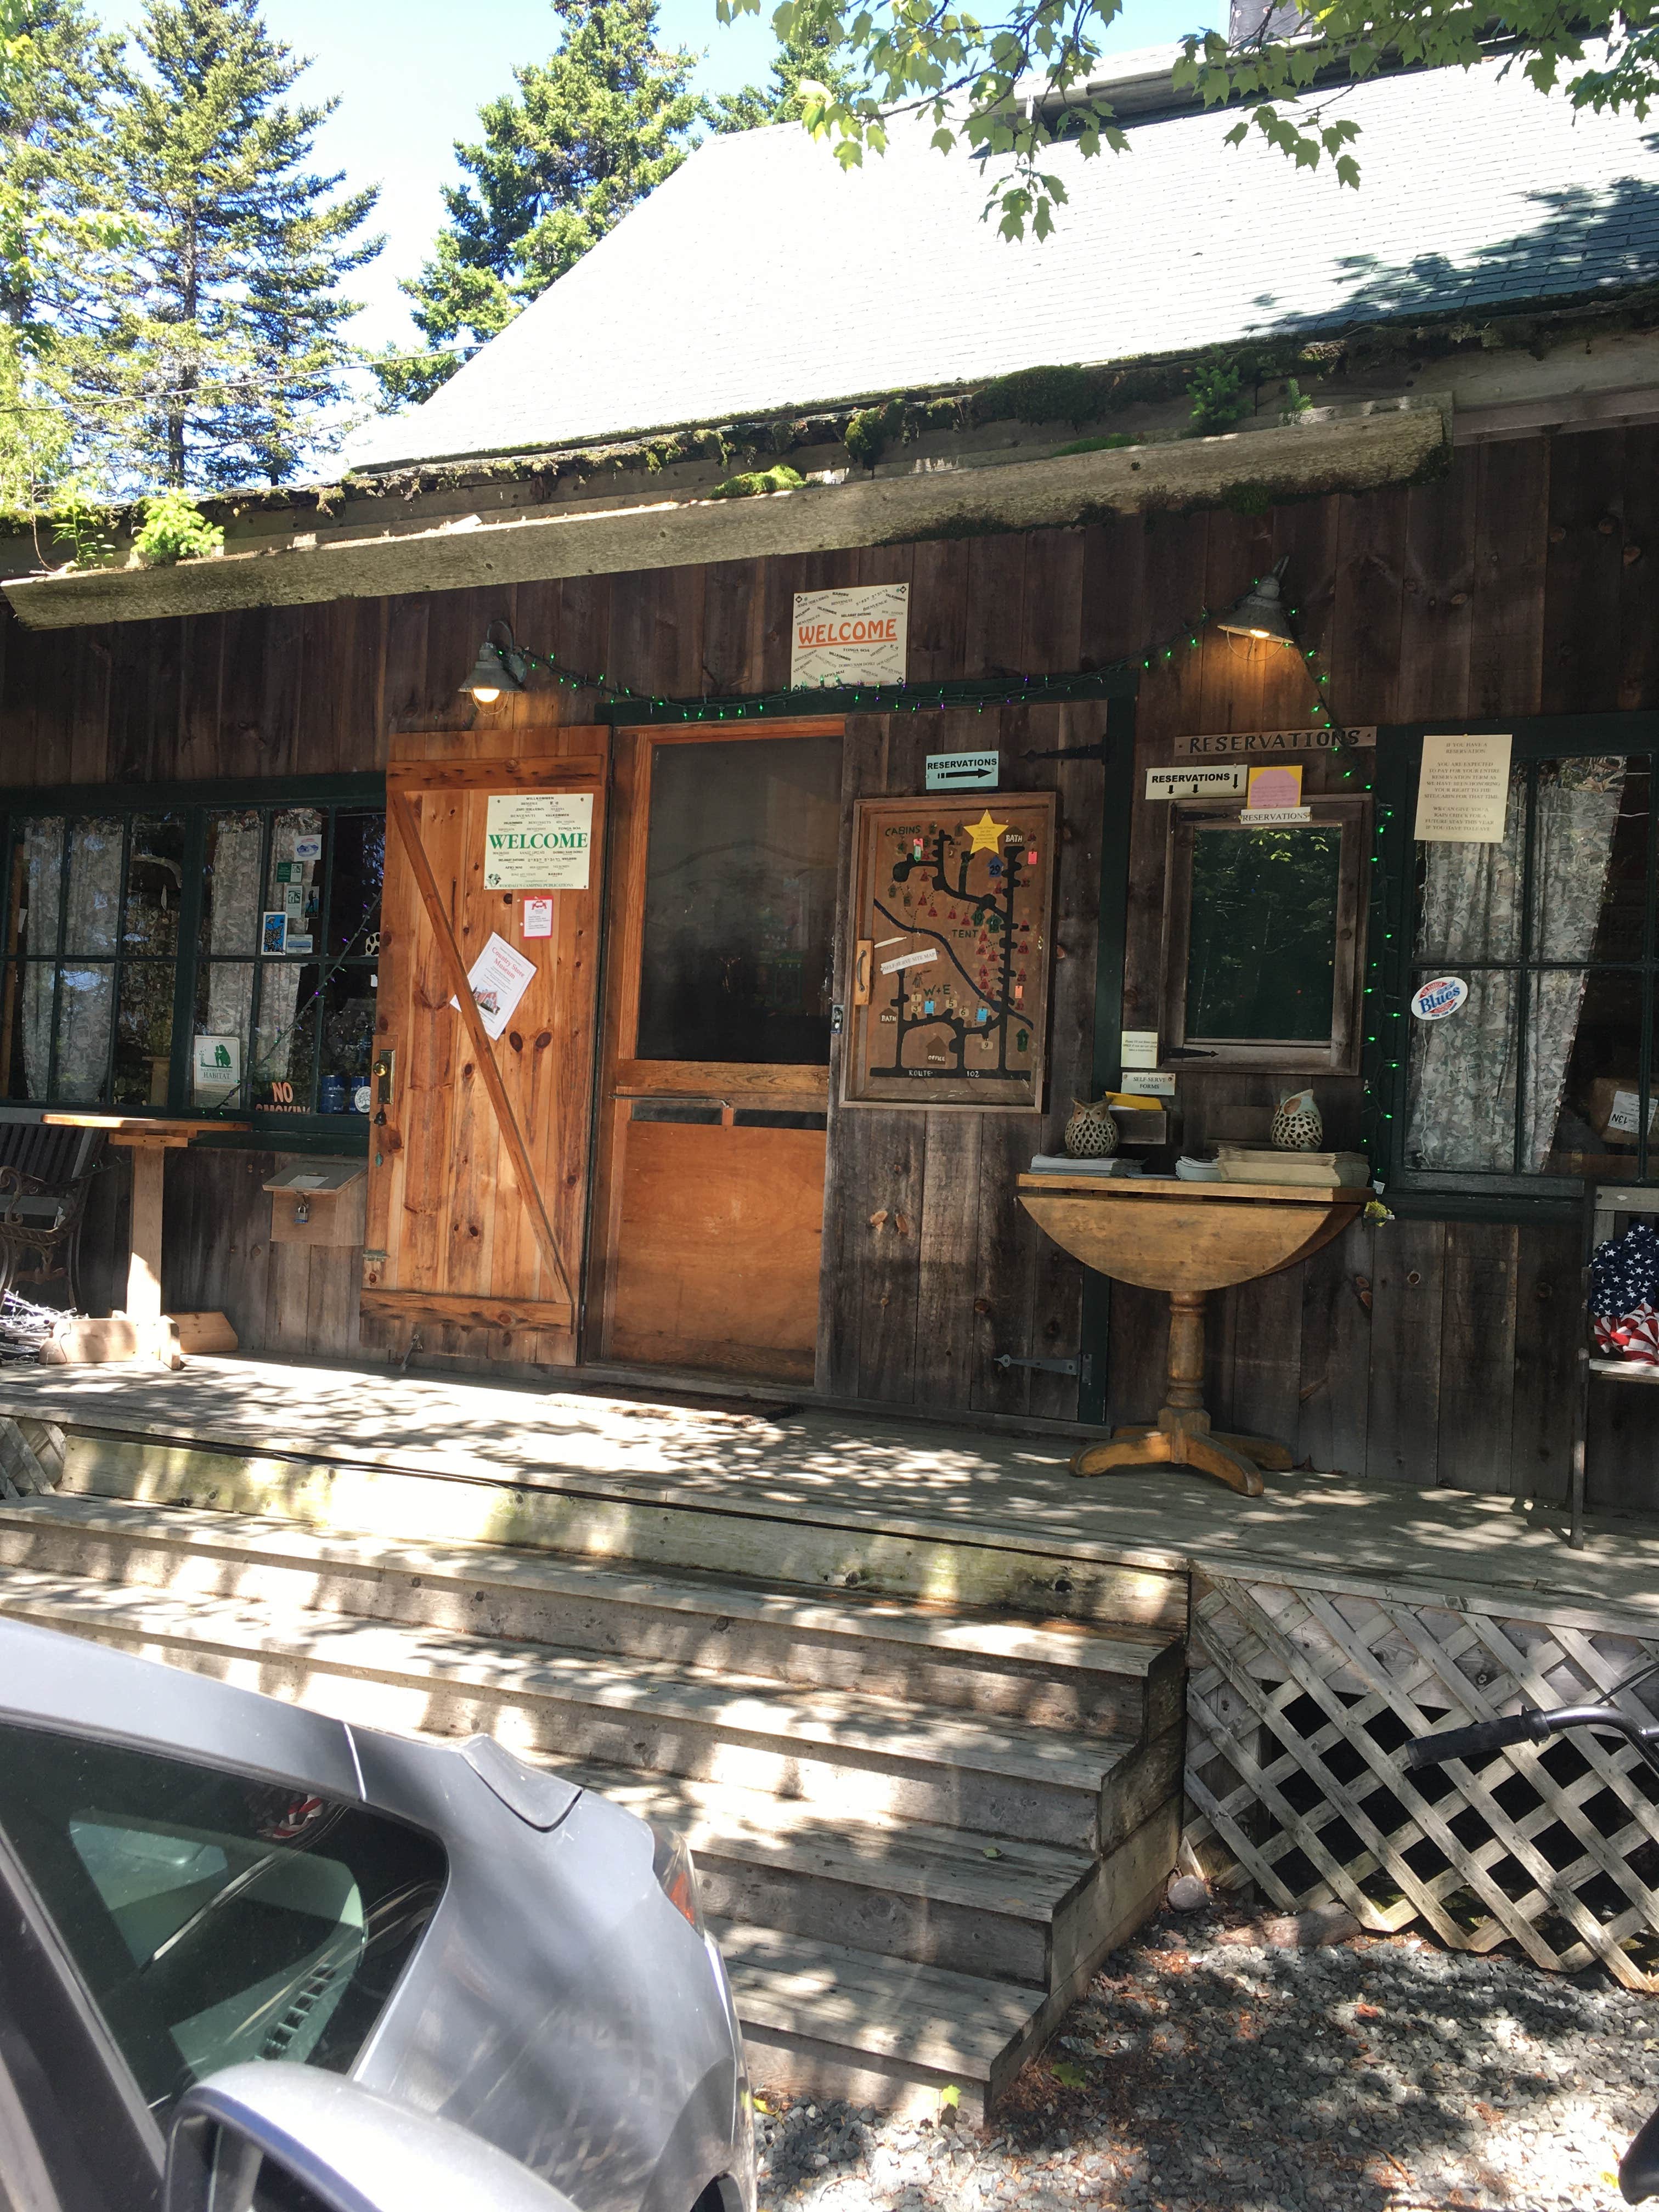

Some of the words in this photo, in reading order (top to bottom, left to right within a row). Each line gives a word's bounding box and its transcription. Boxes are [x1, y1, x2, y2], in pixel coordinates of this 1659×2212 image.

[798, 618, 897, 645] WELCOME
[1189, 730, 1361, 754] RESERVATIONS
[927, 758, 997, 770] RESERVATIONS
[1152, 772, 1231, 783] RESERVATIONS
[1243, 812, 1308, 821] RESERVATIONS
[885, 825, 921, 837] CABINS
[488, 832, 588, 850] WELCOME
[1005, 834, 1023, 843] BATH
[990, 865, 1001, 876] 29
[952, 929, 979, 938] TENT
[492, 947, 511, 967] Country
[512, 963, 525, 978] Store
[494, 958, 516, 980] Museum
[949, 999, 953, 1007] 5
[1418, 986, 1460, 1014] Blues
[272, 1082, 294, 1103] NO
[1611, 1114, 1628, 1125] 13N
